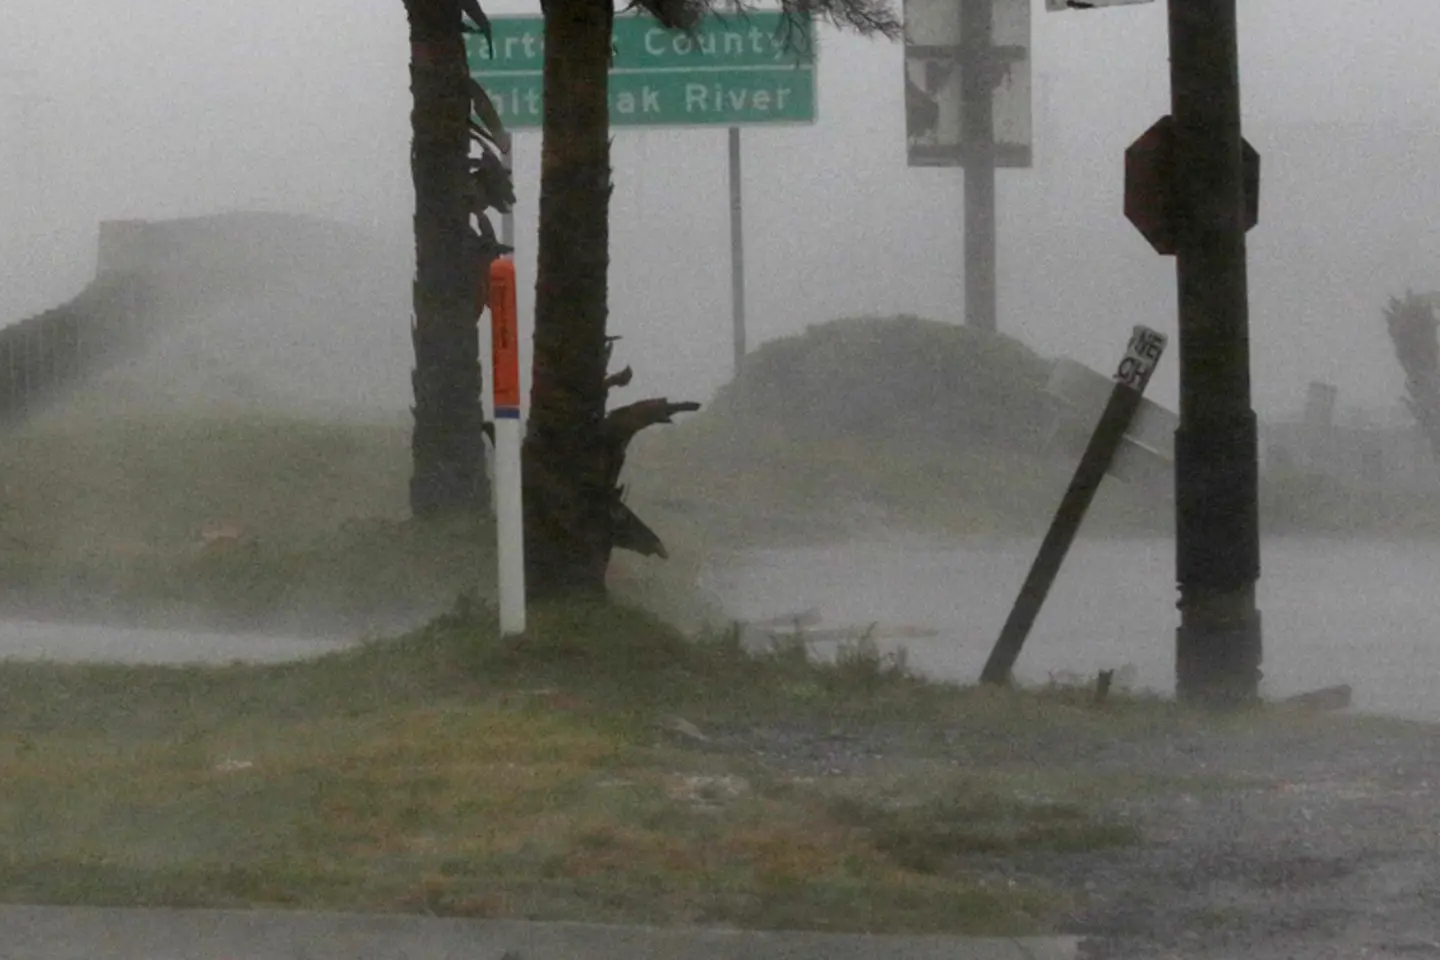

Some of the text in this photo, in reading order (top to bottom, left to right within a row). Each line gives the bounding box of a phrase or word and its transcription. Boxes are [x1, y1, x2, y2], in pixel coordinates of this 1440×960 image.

[643, 26, 783, 60] County
[608, 83, 661, 114] ak
[685, 82, 792, 113] River
